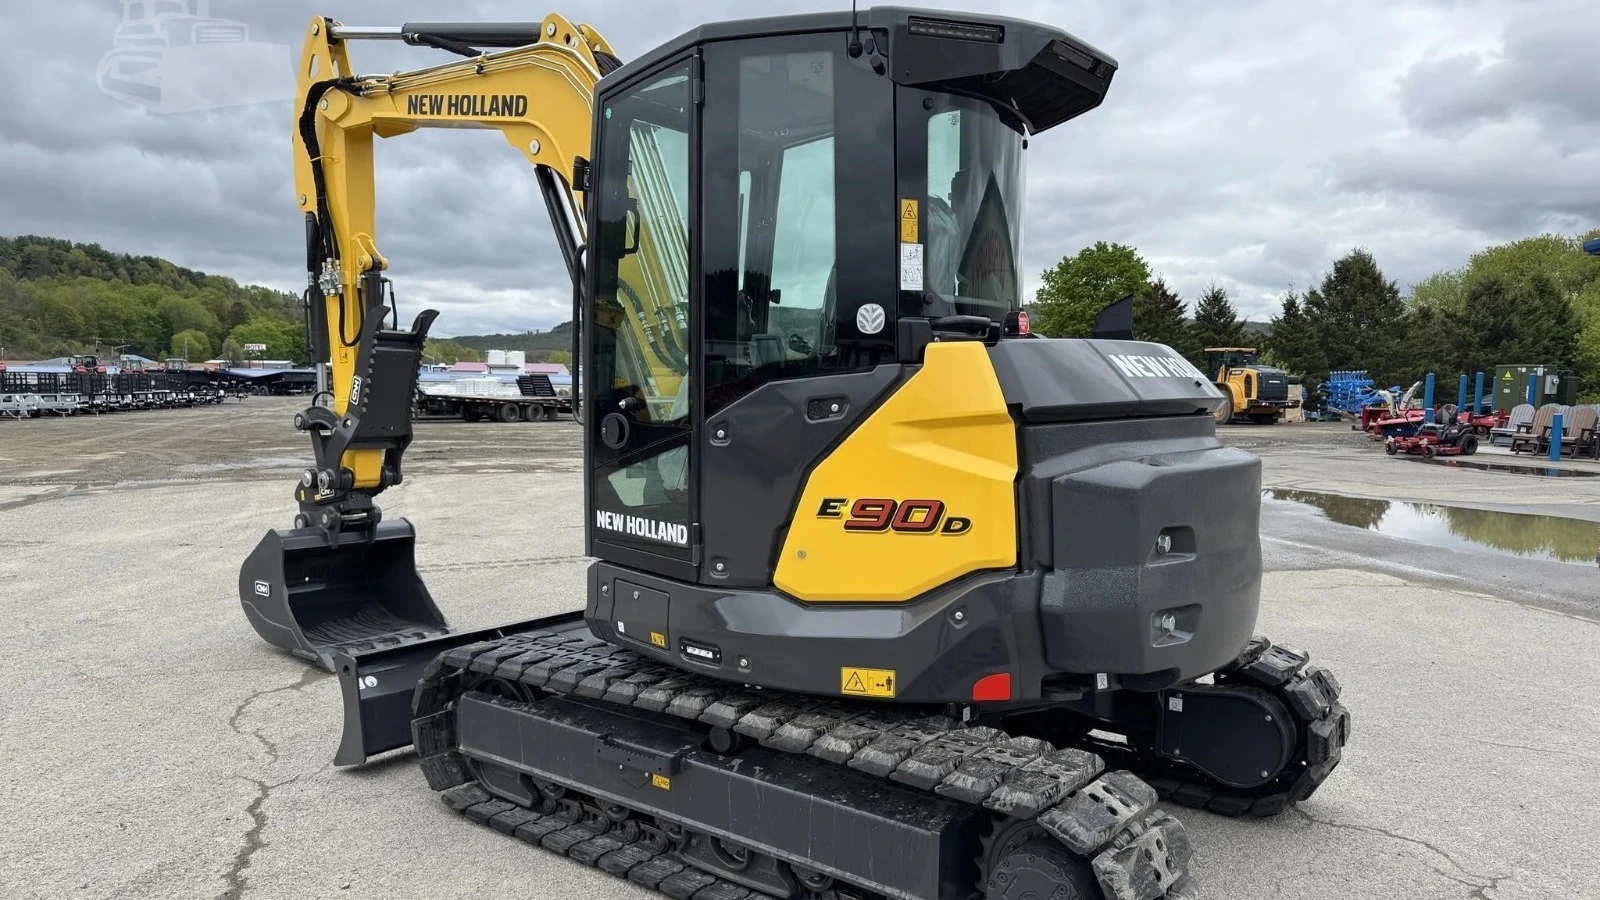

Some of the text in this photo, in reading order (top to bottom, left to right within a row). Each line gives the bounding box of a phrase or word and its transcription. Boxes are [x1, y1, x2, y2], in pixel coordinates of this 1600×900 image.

[408, 95, 528, 117] NEW HOLLAND
[1108, 354, 1171, 378] NEW
[596, 509, 688, 544] NEW HOLLAND
